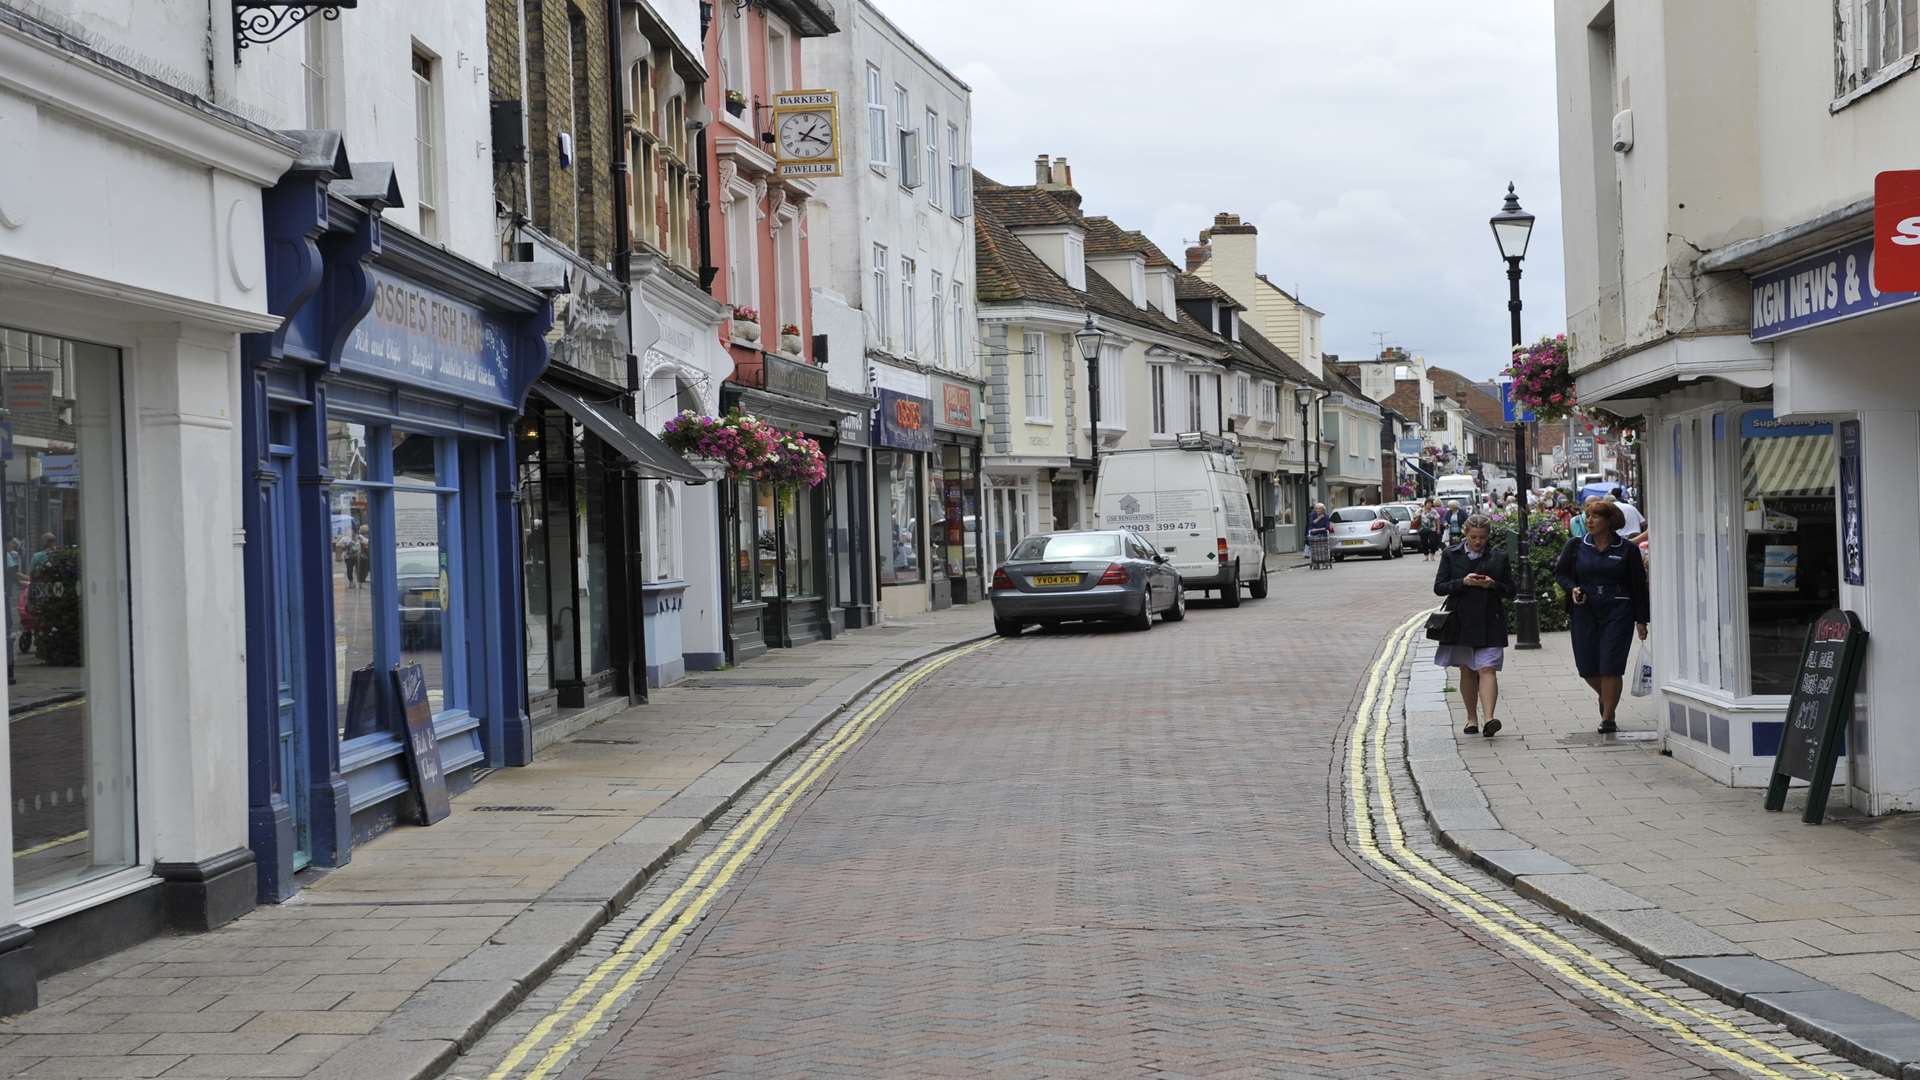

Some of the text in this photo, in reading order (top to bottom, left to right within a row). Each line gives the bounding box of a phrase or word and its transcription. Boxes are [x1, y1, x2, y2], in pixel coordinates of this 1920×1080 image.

[780, 95, 829, 105] BARKERS
[783, 163, 833, 174] JEWELLER
[1753, 279, 1786, 329] KGN
[1790, 261, 1839, 319] NEWS
[1844, 253, 1862, 305] &
[431, 300, 457, 342] FISH
[1752, 416, 1816, 428] Supporting
[1156, 522, 1175, 531] 399
[1177, 521, 1197, 530] 479
